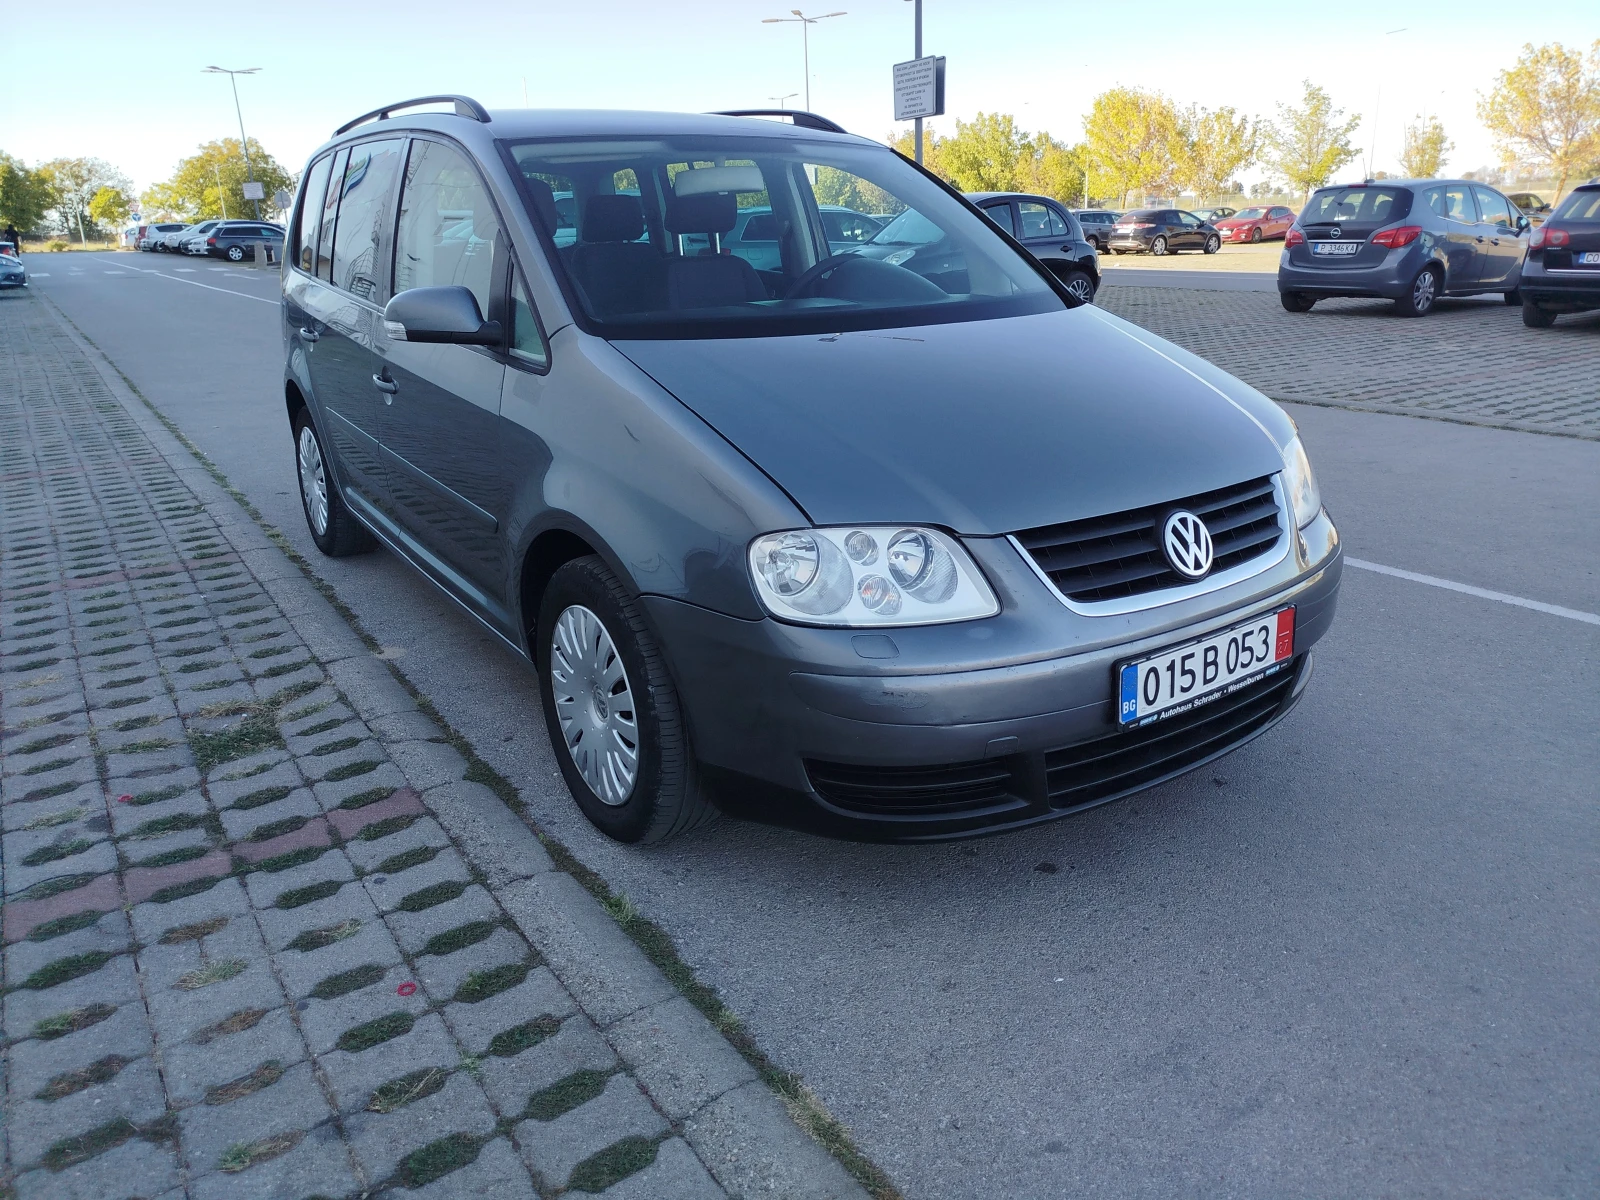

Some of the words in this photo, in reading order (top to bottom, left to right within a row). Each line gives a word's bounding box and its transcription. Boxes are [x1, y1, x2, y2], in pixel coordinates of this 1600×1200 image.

[1123, 699, 1136, 715] BG
[1159, 703, 1192, 720] Autohaus
[1193, 690, 1223, 707] Schrader
